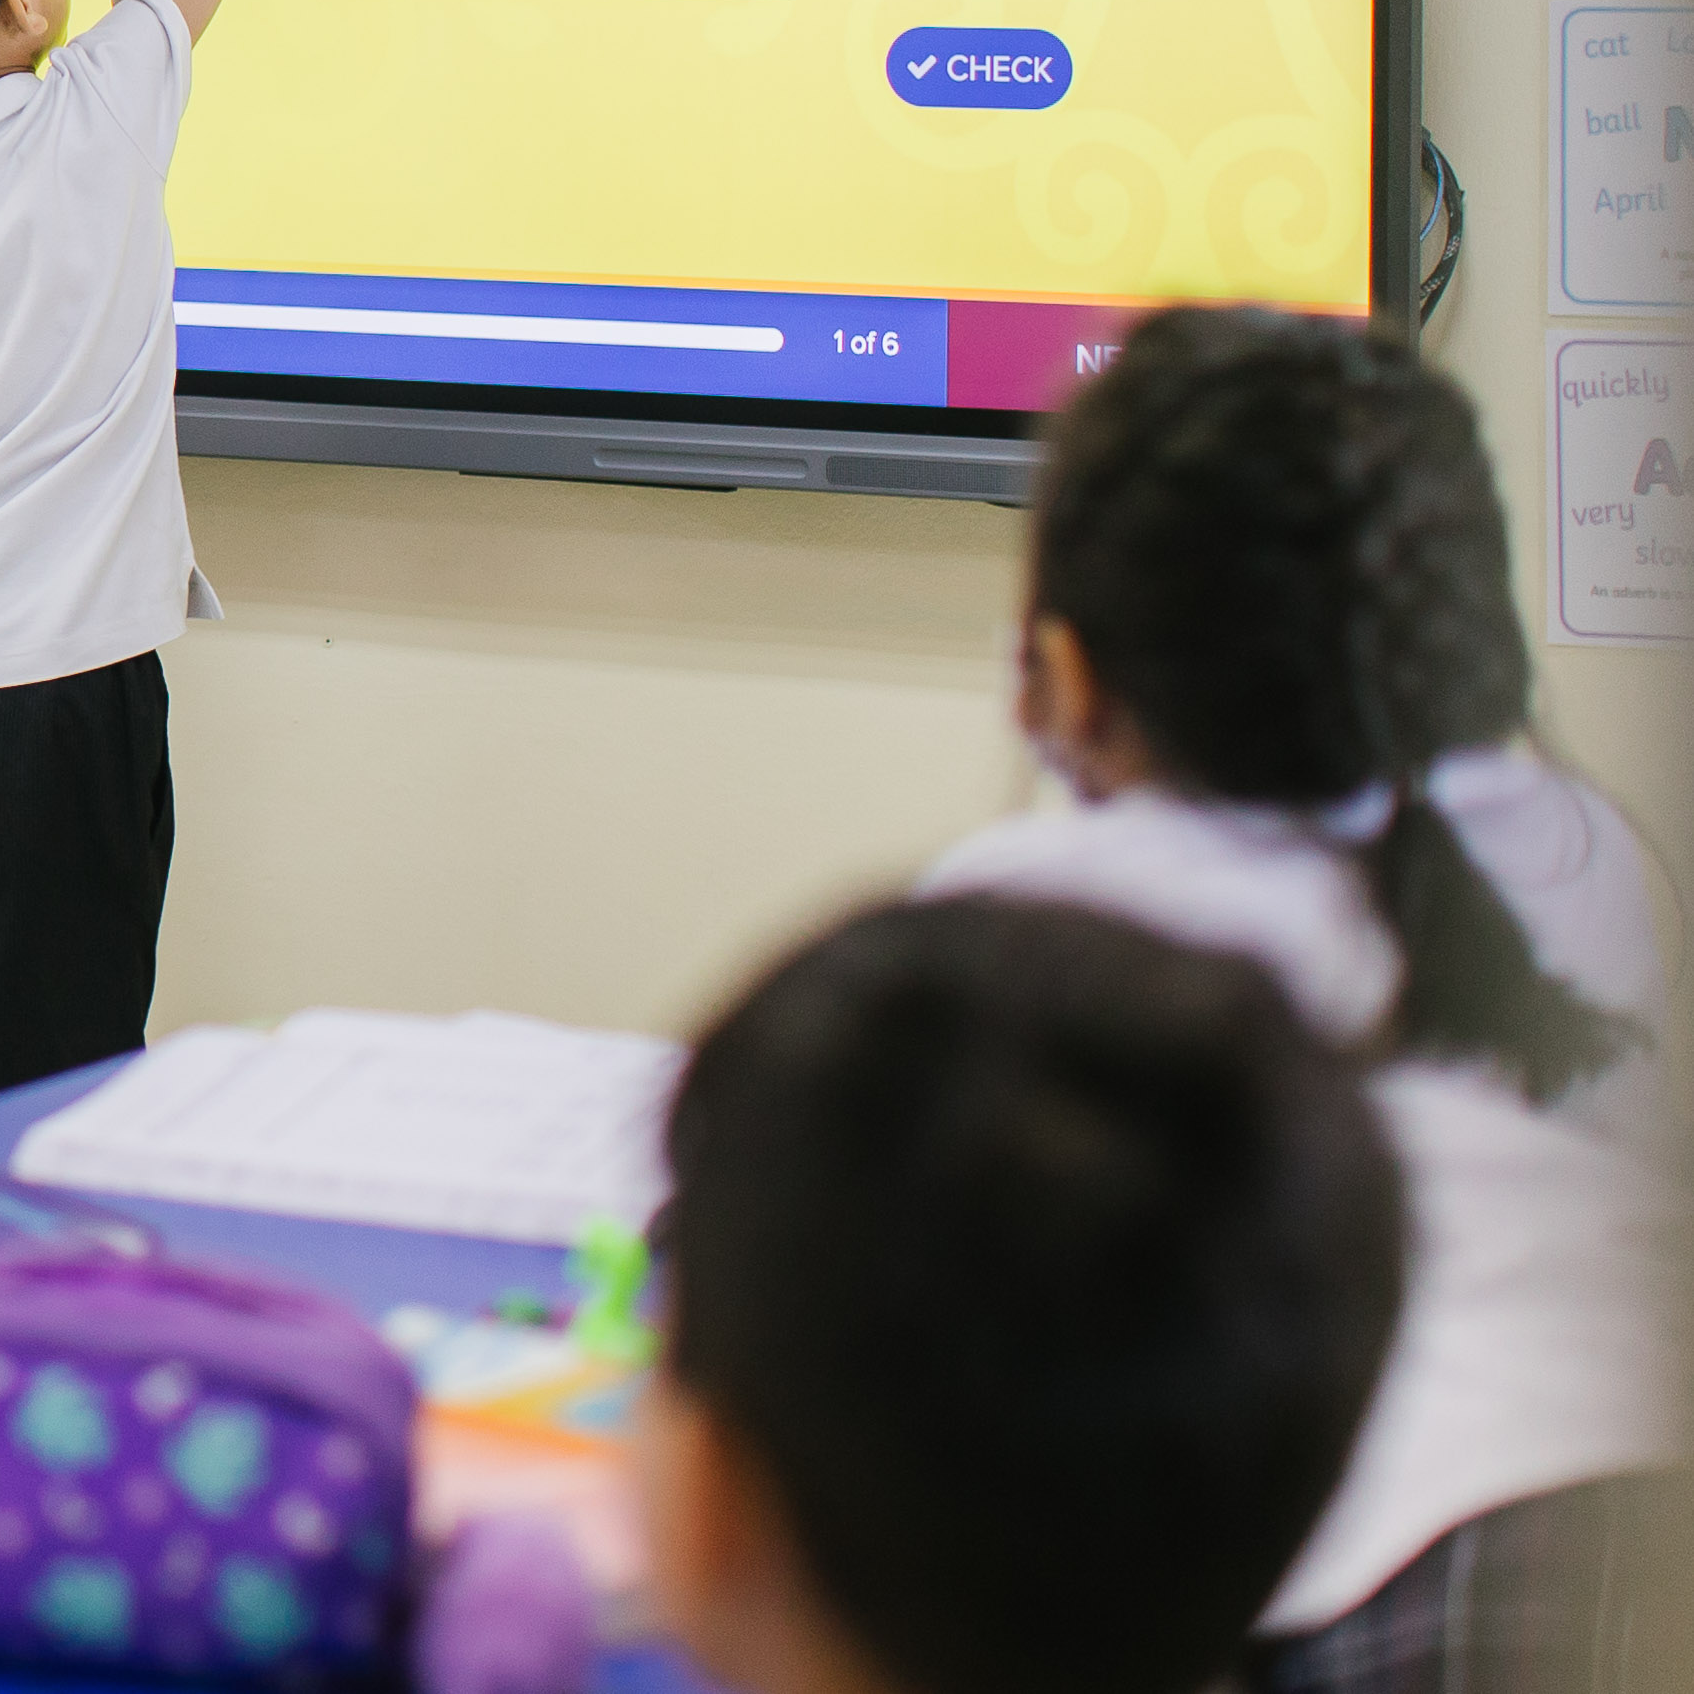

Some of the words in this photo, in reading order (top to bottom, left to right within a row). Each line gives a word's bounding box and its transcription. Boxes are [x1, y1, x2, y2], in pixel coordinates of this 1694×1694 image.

[1584, 33, 1631, 59] cat
[947, 54, 1053, 84] CHECK
[1585, 102, 1642, 136] ball
[833, 330, 844, 354] 1
[850, 330, 876, 355] of
[882, 331, 899, 356] 6
[1562, 368, 1670, 408] quickly
[1571, 503, 1634, 531] very
